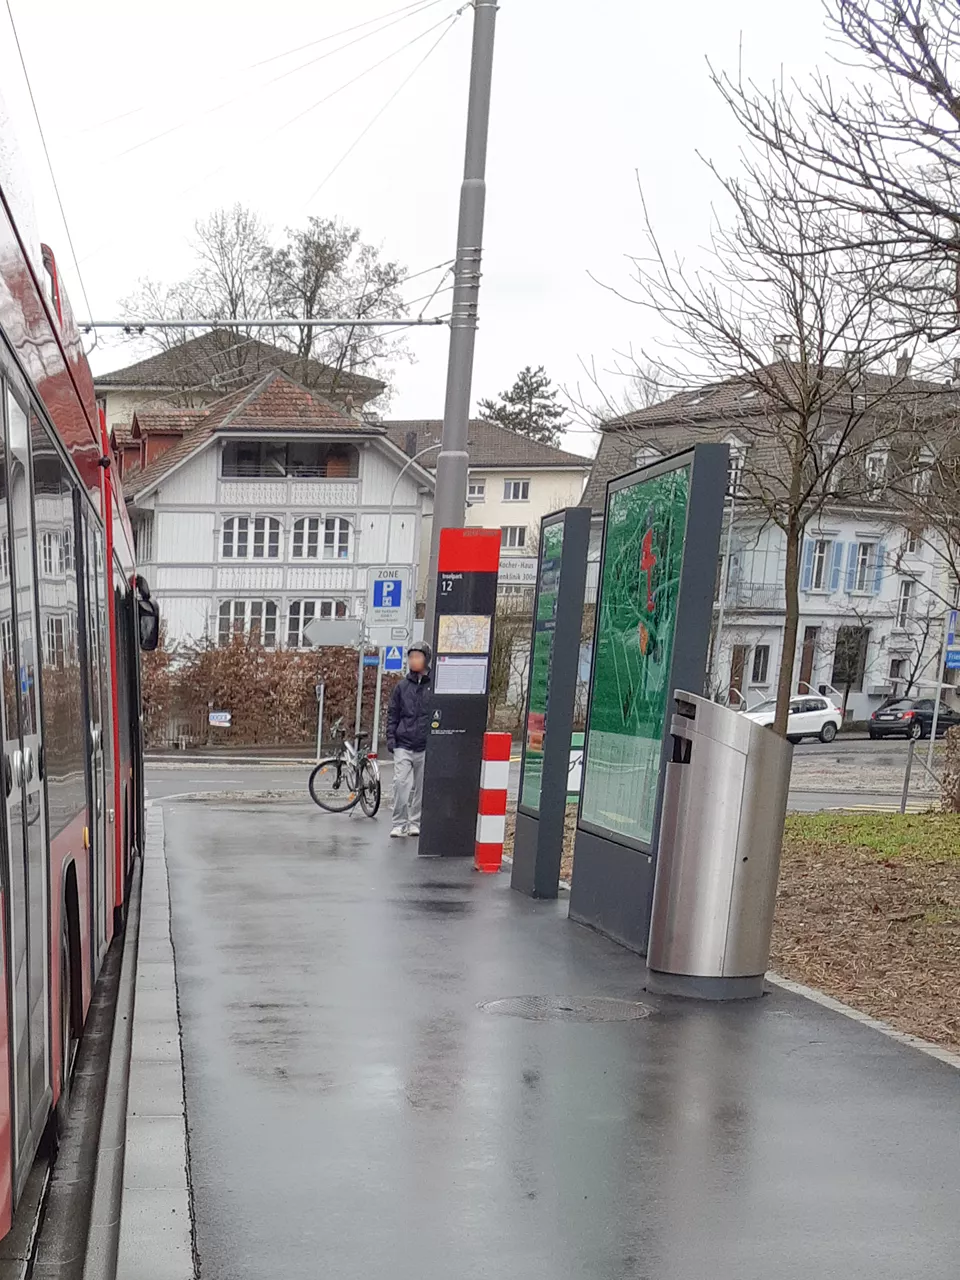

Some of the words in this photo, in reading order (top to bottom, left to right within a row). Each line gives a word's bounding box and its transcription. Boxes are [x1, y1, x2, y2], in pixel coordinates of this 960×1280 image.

[378, 570, 399, 579] ZONE
[382, 581, 395, 596] P
[442, 580, 453, 592] 12
